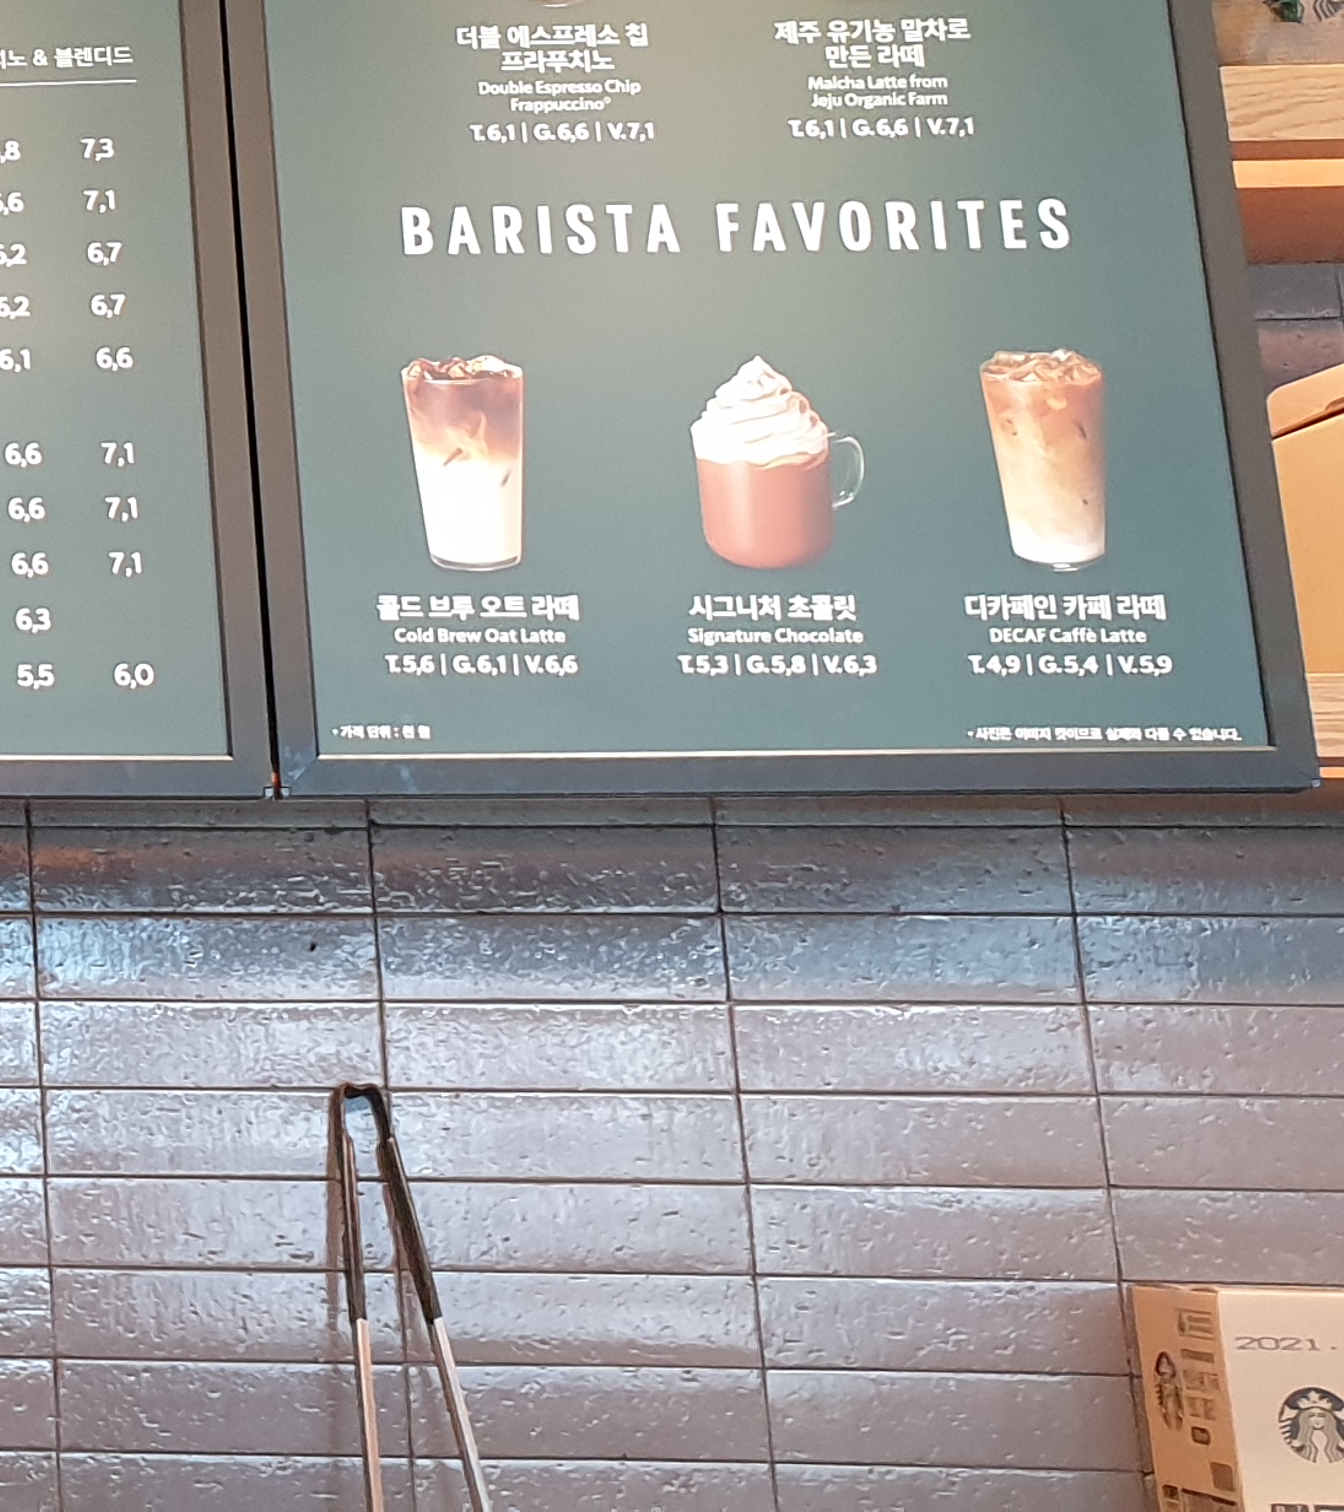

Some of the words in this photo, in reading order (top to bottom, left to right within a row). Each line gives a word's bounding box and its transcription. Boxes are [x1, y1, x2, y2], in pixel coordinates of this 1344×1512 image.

[456, 25, 502, 50] 더블
[506, 23, 621, 49] 에스프레소
[624, 22, 649, 47] 칩
[32, 48, 49, 66] &
[53, 46, 134, 68] 블렌디드
[500, 49, 616, 74] 프라푸치노
[80, 138, 115, 162] 7,3
[401, 203, 681, 255] BARISTA
[715, 198, 1070, 253] FAVORITES
[15, 607, 51, 634] 6,3
[394, 627, 435, 643] Cold
[437, 627, 482, 643] Brew
[484, 627, 519, 644] Oat
[520, 627, 566, 644] Latte
[687, 627, 772, 647] Signature
[774, 627, 864, 644] Chocolate
[989, 627, 1047, 643] DECAF
[1100, 627, 1147, 643] Latte
